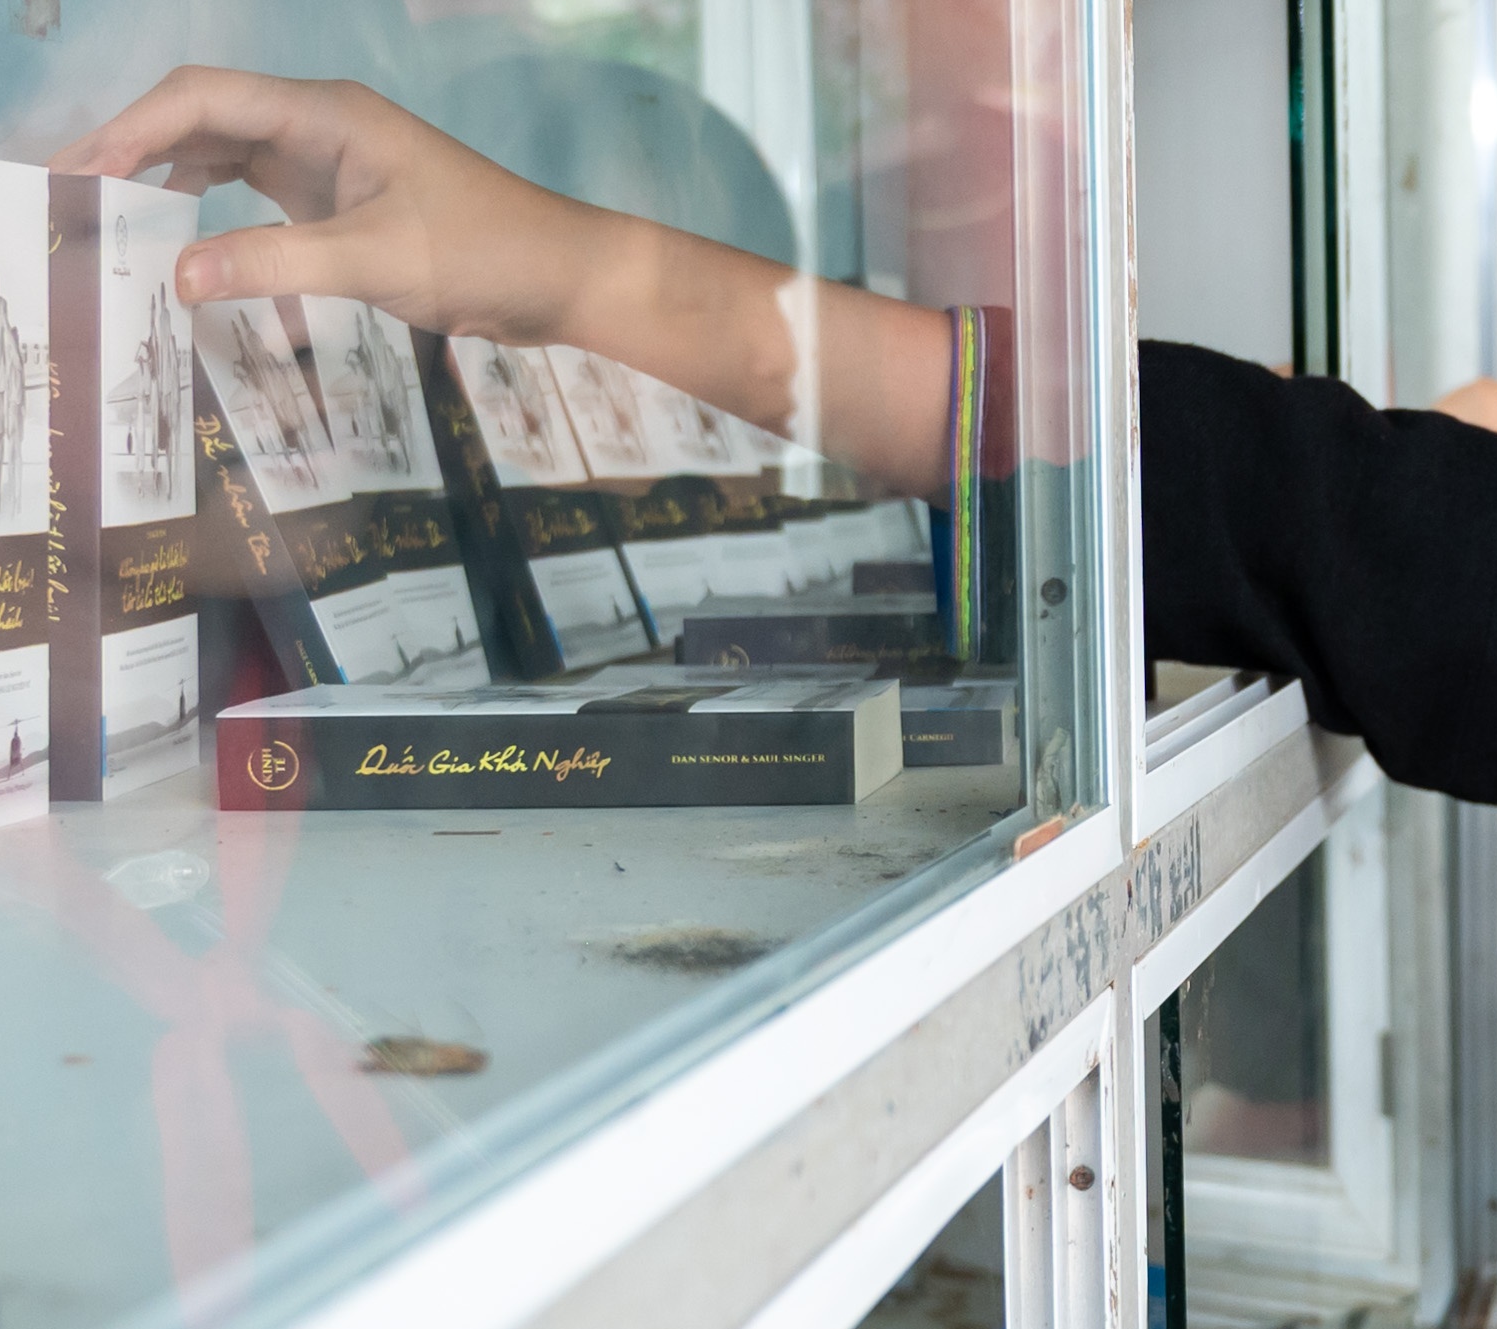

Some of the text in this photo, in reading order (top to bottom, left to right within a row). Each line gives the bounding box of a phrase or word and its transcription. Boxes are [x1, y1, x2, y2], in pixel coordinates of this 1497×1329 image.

[262, 747, 272, 783] KINH
[355, 744, 424, 775] Quốc
[429, 749, 475, 774] Gia
[533, 747, 612, 782] Nghiệp
[671, 752, 827, 764] DAN SENOR & SAUL SINGER
